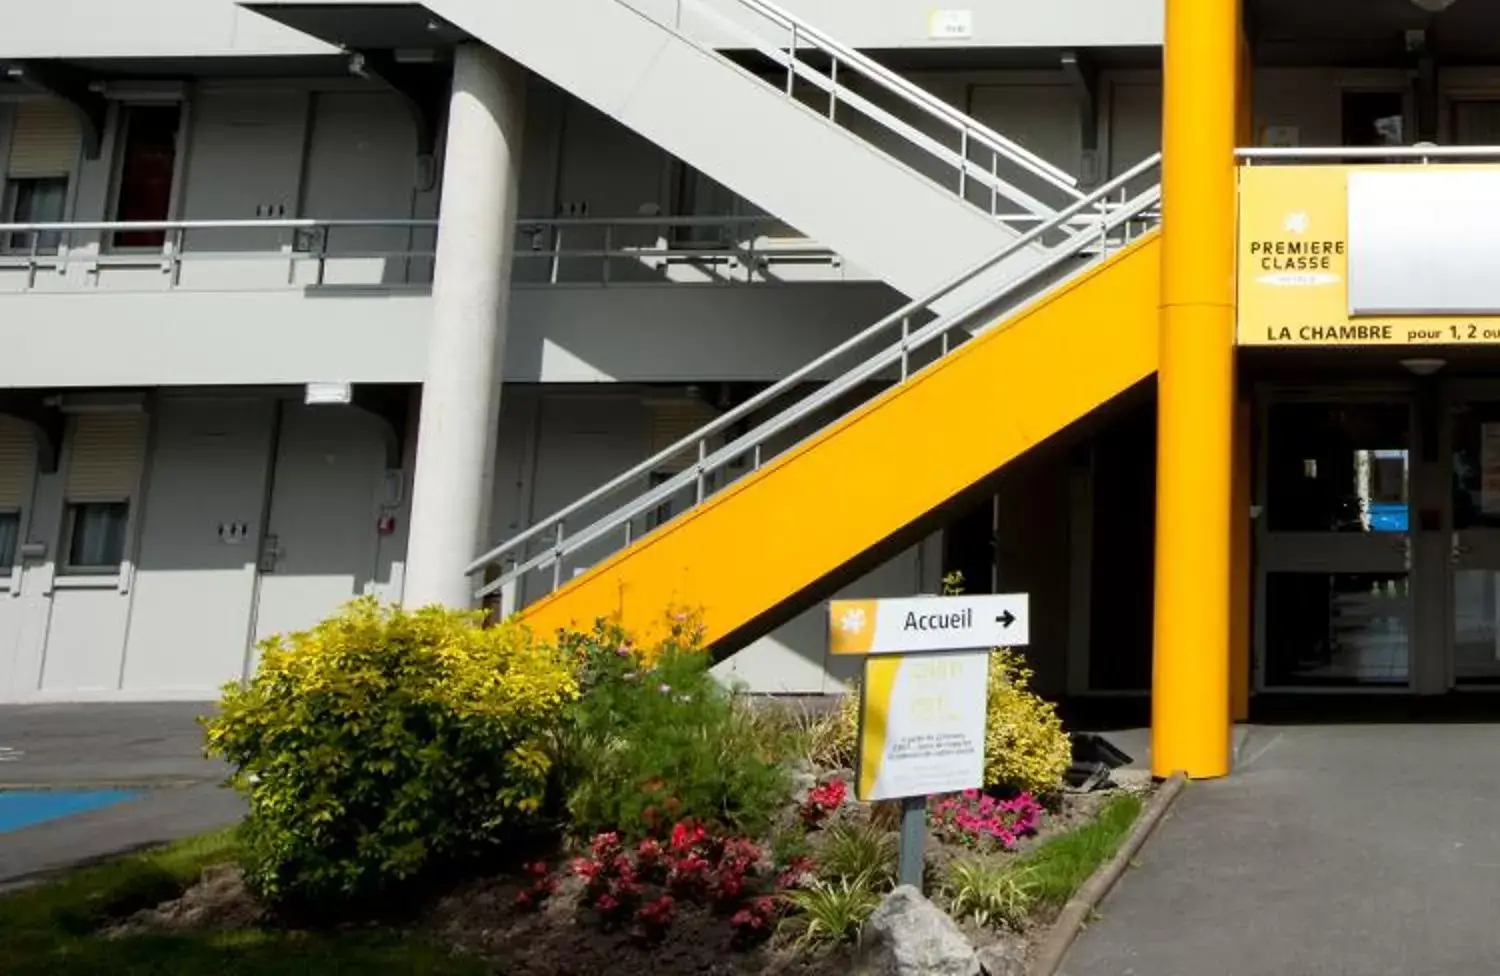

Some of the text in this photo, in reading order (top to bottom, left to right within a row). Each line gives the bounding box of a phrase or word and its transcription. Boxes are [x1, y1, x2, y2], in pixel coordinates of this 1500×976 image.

[1250, 241, 1345, 255] PREMIERE
[1261, 256, 1329, 270] CLASSE
[1267, 325, 1292, 340] LA
[1299, 325, 1393, 340] CHAMBRE
[1407, 328, 1442, 341] pour
[1467, 324, 1477, 339] 2
[1483, 328, 1500, 339] ou
[904, 608, 973, 631] Accueil
